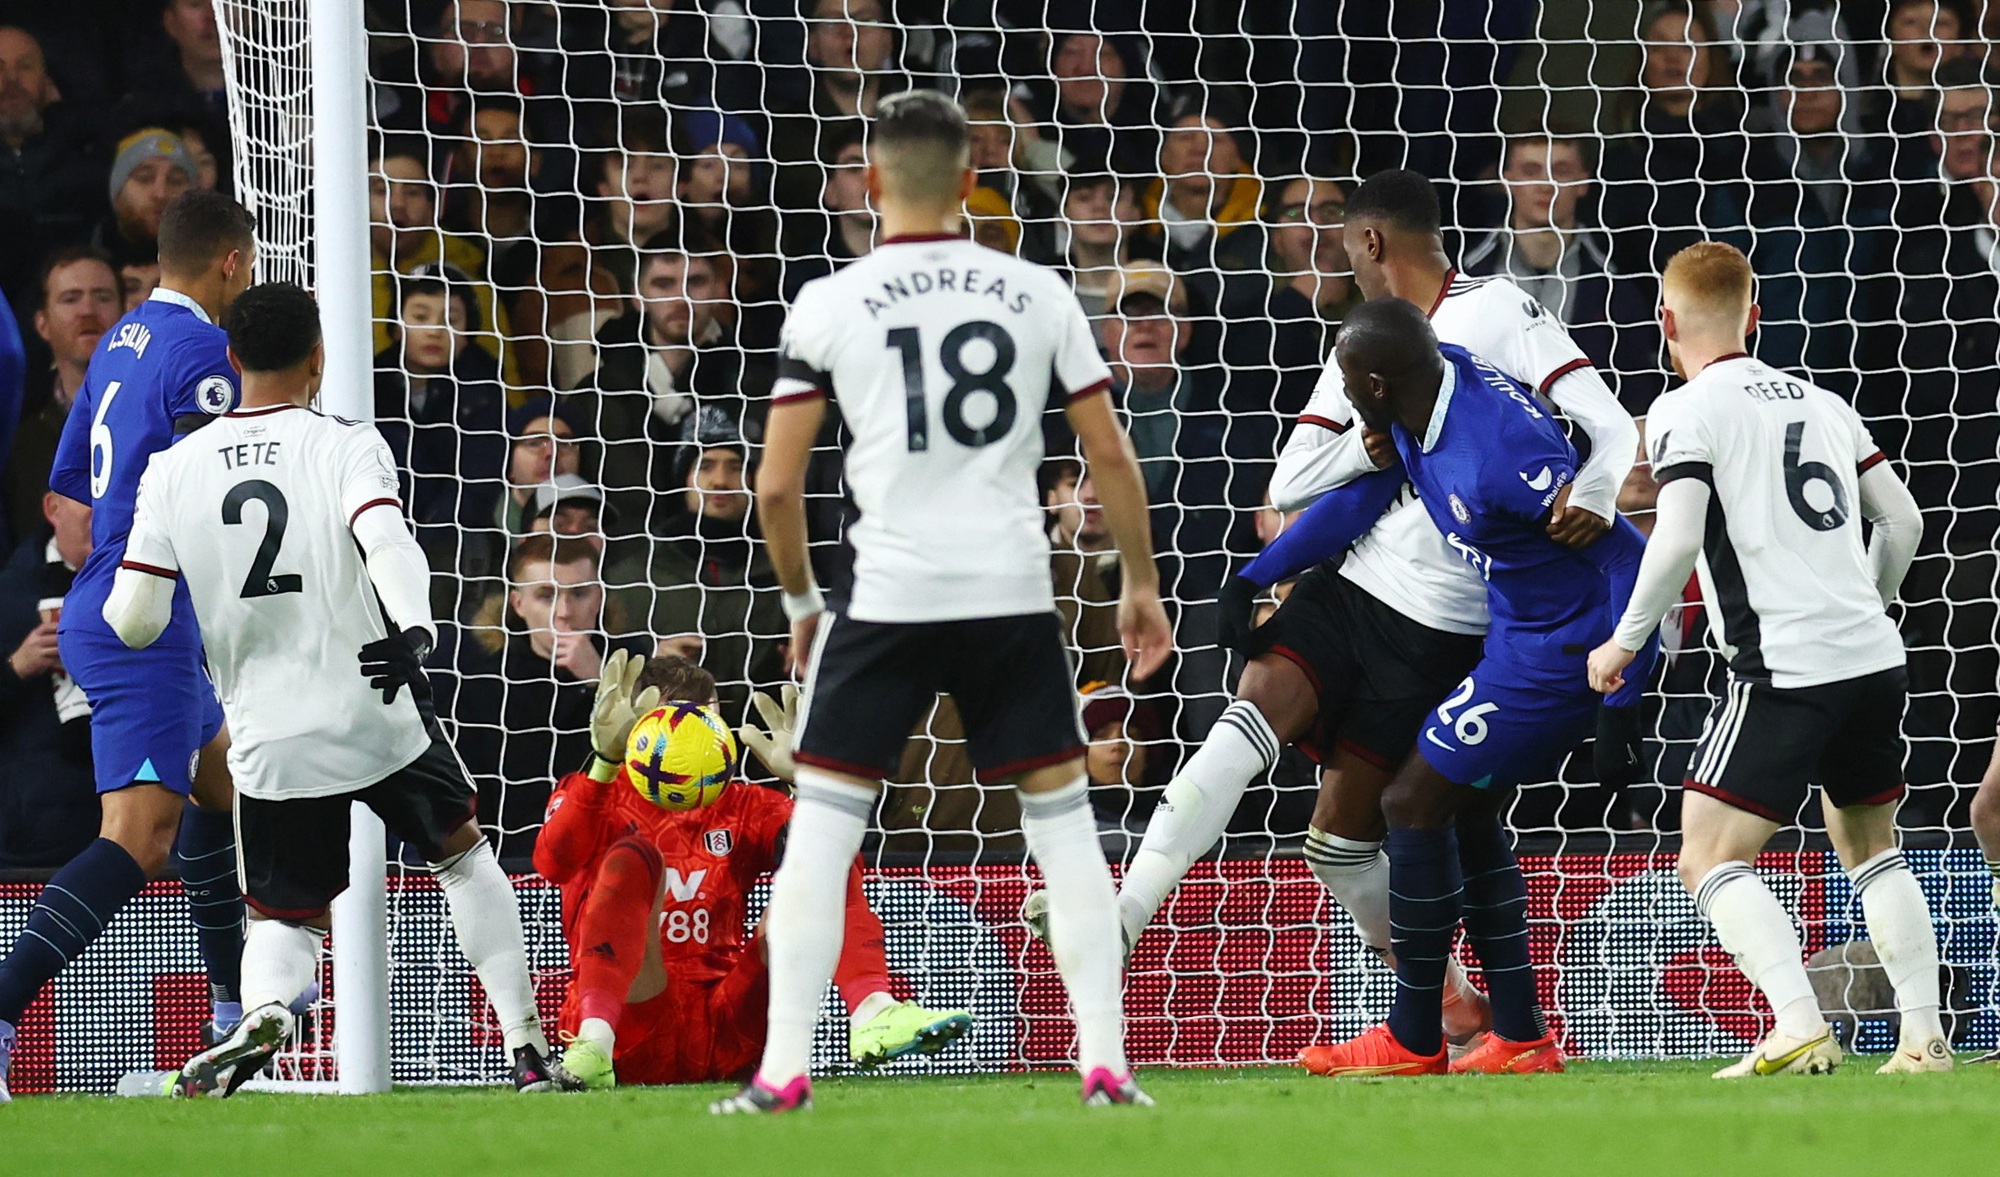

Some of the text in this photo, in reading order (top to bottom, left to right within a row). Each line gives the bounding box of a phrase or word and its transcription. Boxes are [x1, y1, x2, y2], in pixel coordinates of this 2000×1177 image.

[864, 268, 1033, 320] ANDREAS
[886, 320, 1018, 453] 18
[90, 381, 122, 499] 6
[218, 441, 281, 470] TETE
[1783, 421, 1849, 531] 6
[1541, 471, 1568, 507] WhaleFin
[222, 479, 303, 599] 2
[1437, 676, 1499, 746] 26
